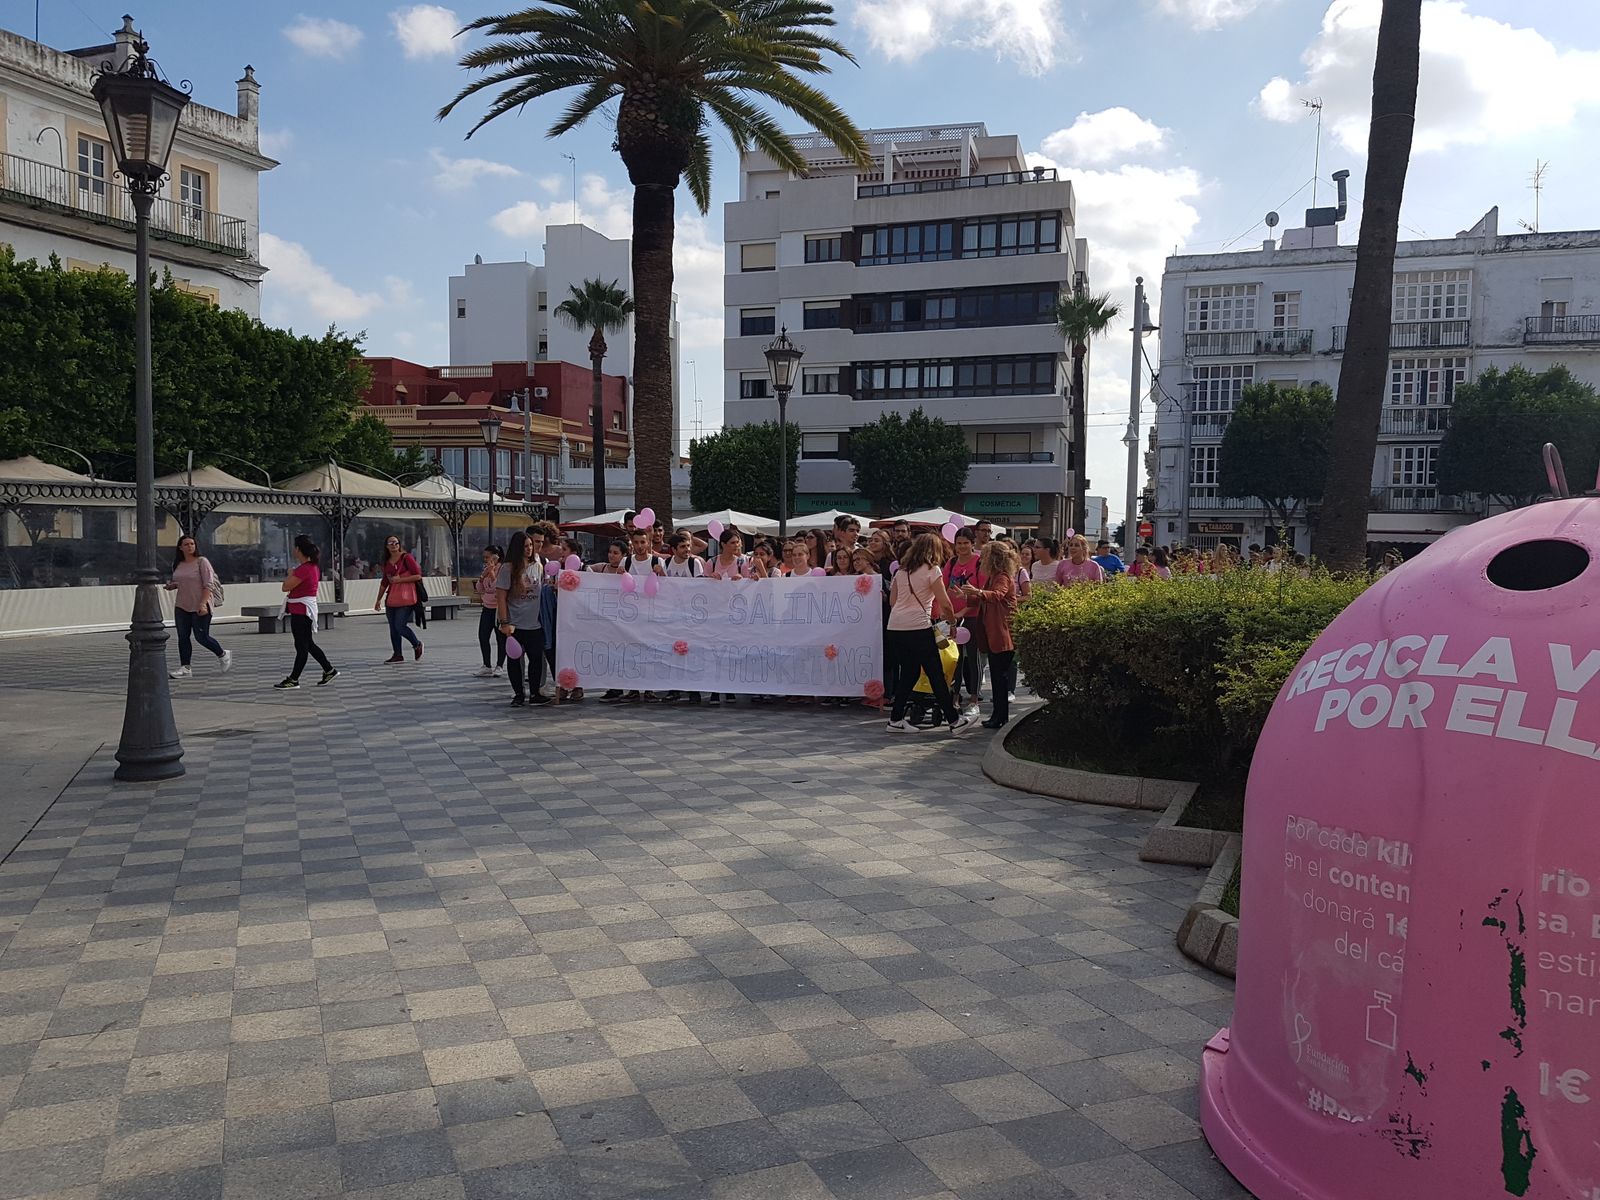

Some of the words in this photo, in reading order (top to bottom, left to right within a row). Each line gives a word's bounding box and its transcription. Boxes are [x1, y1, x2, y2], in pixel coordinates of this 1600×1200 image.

[576, 587, 640, 623] IES
[648, 592, 709, 624] LS
[728, 591, 863, 625] SALINAS
[1286, 634, 1518, 701] RECICLA
[1314, 681, 1435, 732] POR
[1445, 684, 1600, 760] ELL
[1286, 814, 1313, 840] Por
[1318, 830, 1368, 857] cada
[1377, 839, 1413, 867] kil
[1284, 852, 1302, 871] en
[1308, 857, 1322, 878] el
[1329, 867, 1410, 904] conten
[1303, 888, 1375, 930] donará
[1335, 931, 1368, 963] del
[1378, 946, 1404, 974] cá
[1538, 951, 1600, 977] esti
